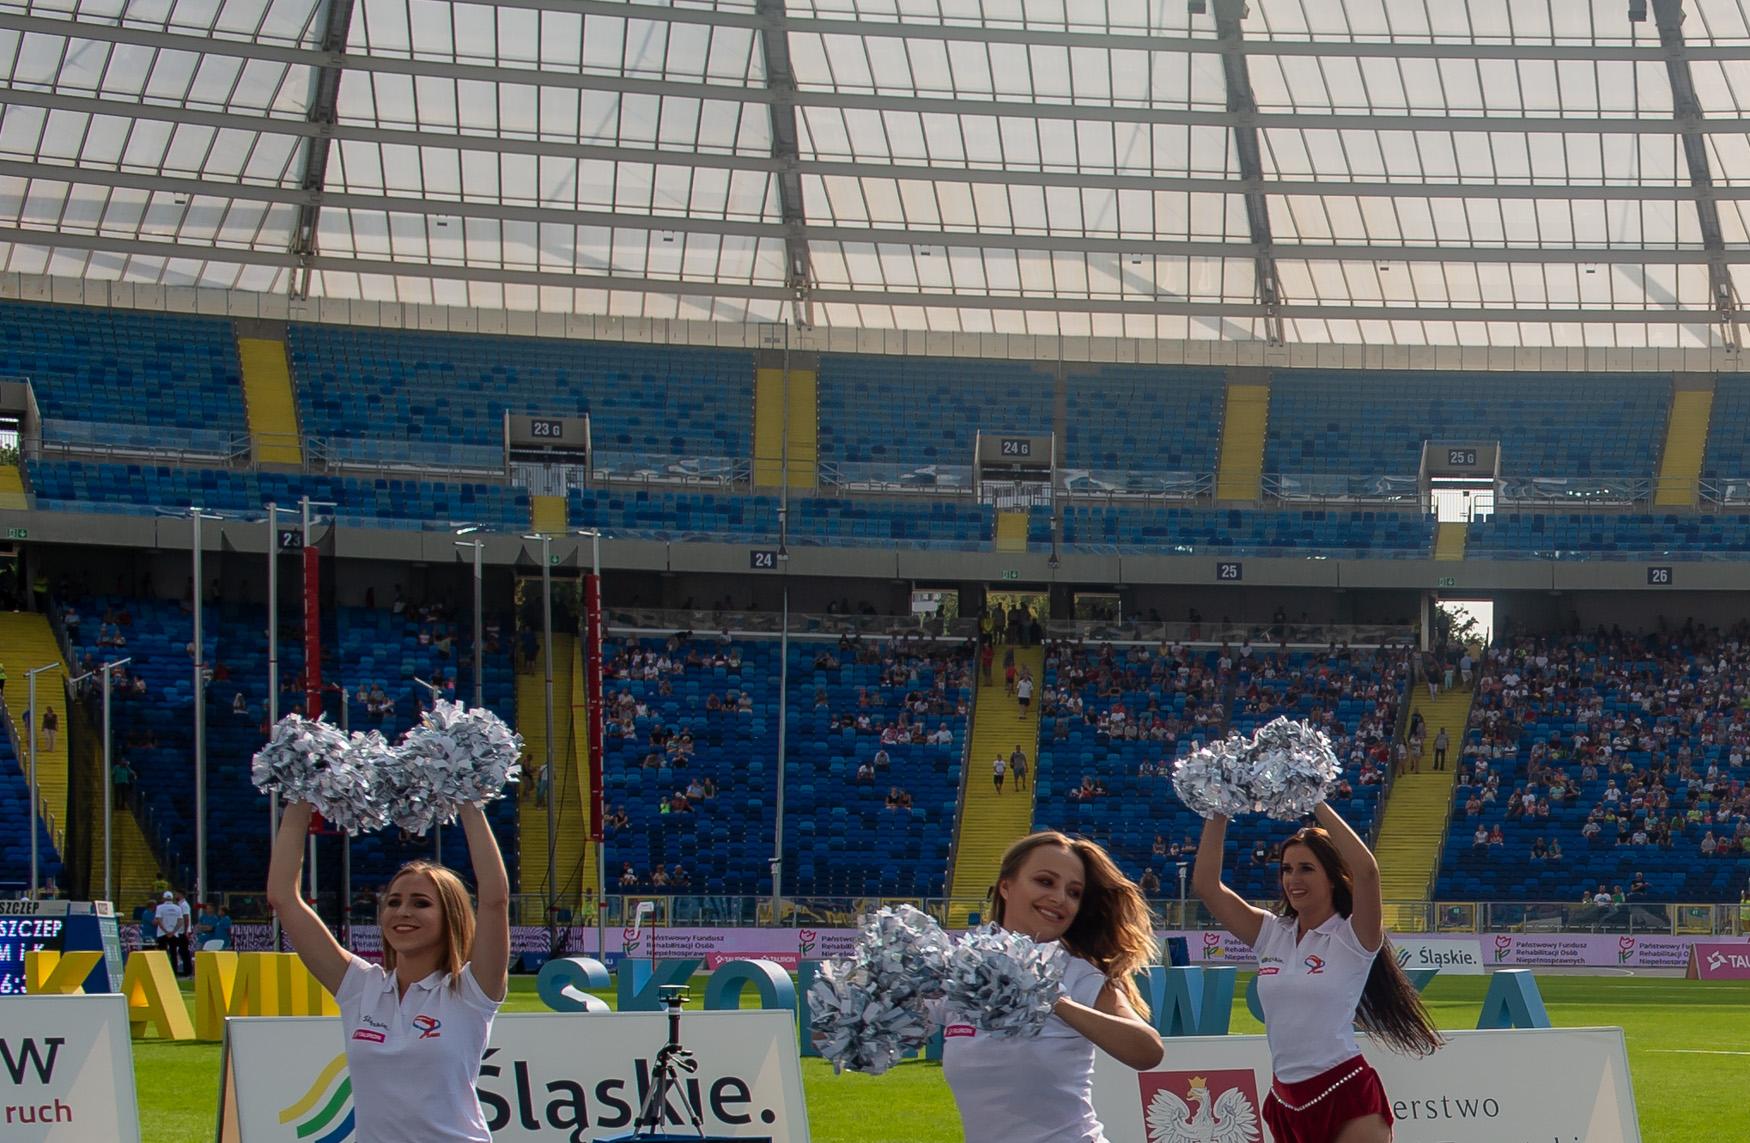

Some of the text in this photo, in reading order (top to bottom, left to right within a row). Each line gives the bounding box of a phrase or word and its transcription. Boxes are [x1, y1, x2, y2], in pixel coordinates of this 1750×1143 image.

[534, 422, 561, 436] 23 G
[1004, 441, 1028, 454] 24 G
[1450, 451, 1474, 464] 25 G
[283, 532, 301, 547] 23
[755, 553, 772, 567] 24
[1221, 564, 1237, 578] 25
[1653, 569, 1668, 583] 26
[646, 934, 691, 942] Pństwowy
[1516, 941, 1588, 949] Państwowy Fundusz
[1516, 949, 1559, 957] Rehabilitacji
[1639, 942, 1681, 951] Państwowy
[1420, 946, 1477, 967] Śląskie.
[6, 1098, 73, 1123] ruch
